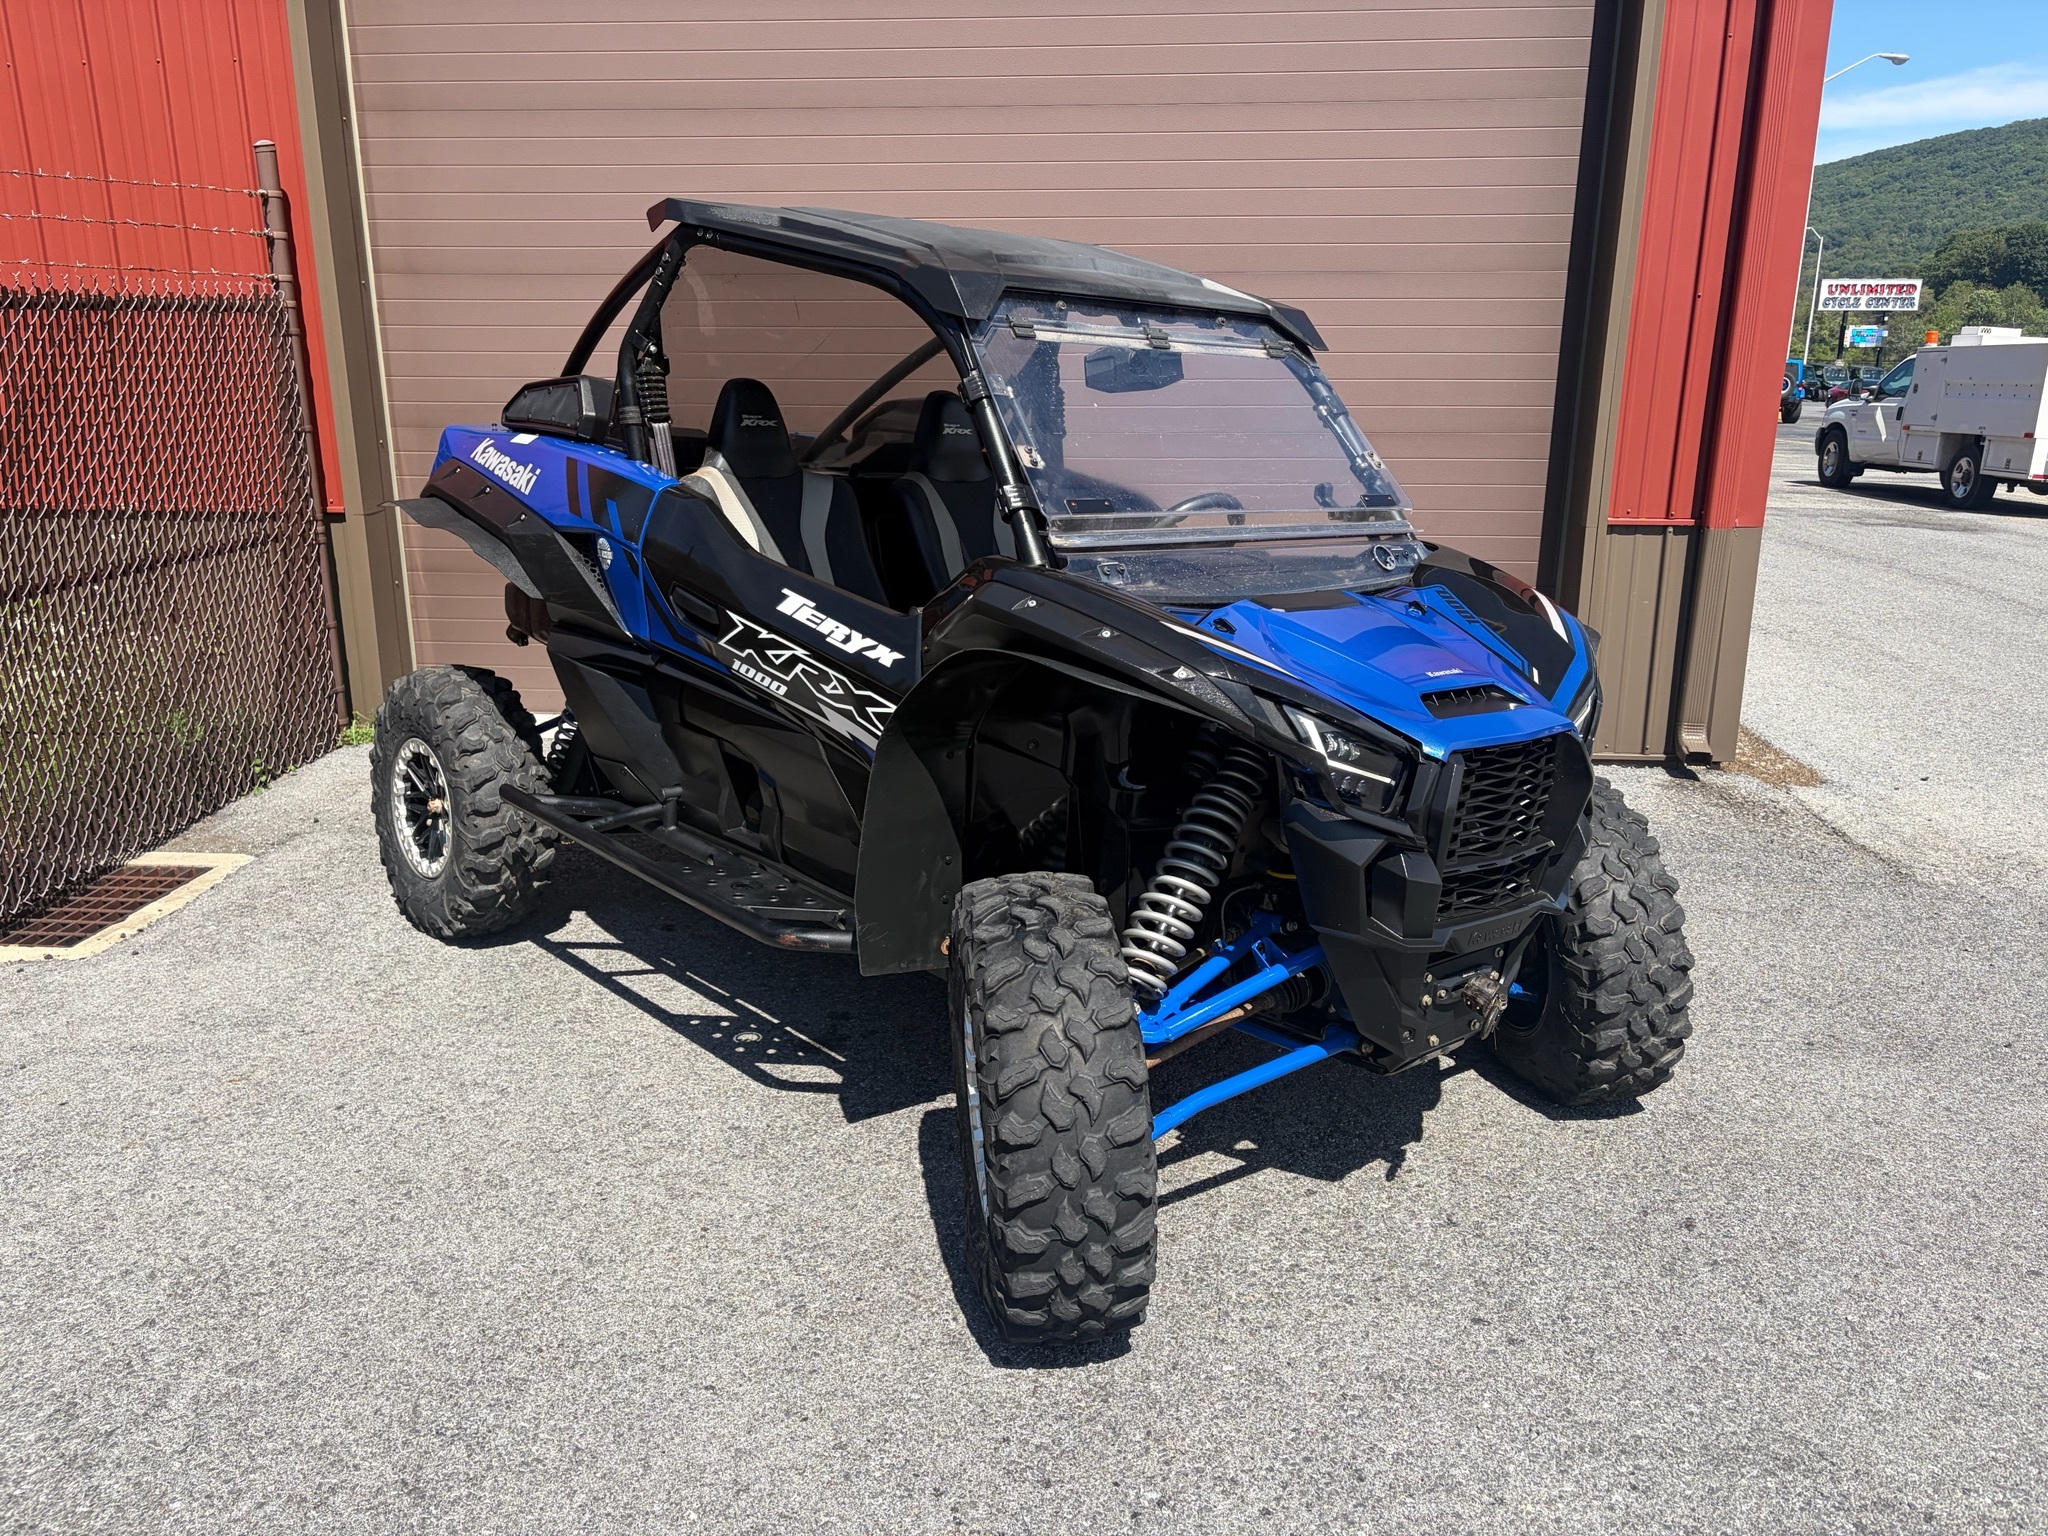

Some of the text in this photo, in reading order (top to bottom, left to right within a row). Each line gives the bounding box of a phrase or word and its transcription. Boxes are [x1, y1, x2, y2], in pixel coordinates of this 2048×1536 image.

[1828, 284, 1917, 295] UNLIMITED
[1822, 297, 1915, 308] CYCLE CENTER
[740, 418, 778, 427] KRX
[942, 427, 973, 435] KRX
[470, 437, 541, 496] Kawasaki
[718, 609, 898, 736] KRX
[731, 658, 788, 696] 1000
[1425, 668, 1464, 678] Kawasaki
[1467, 919, 1523, 946] Kawasaki
